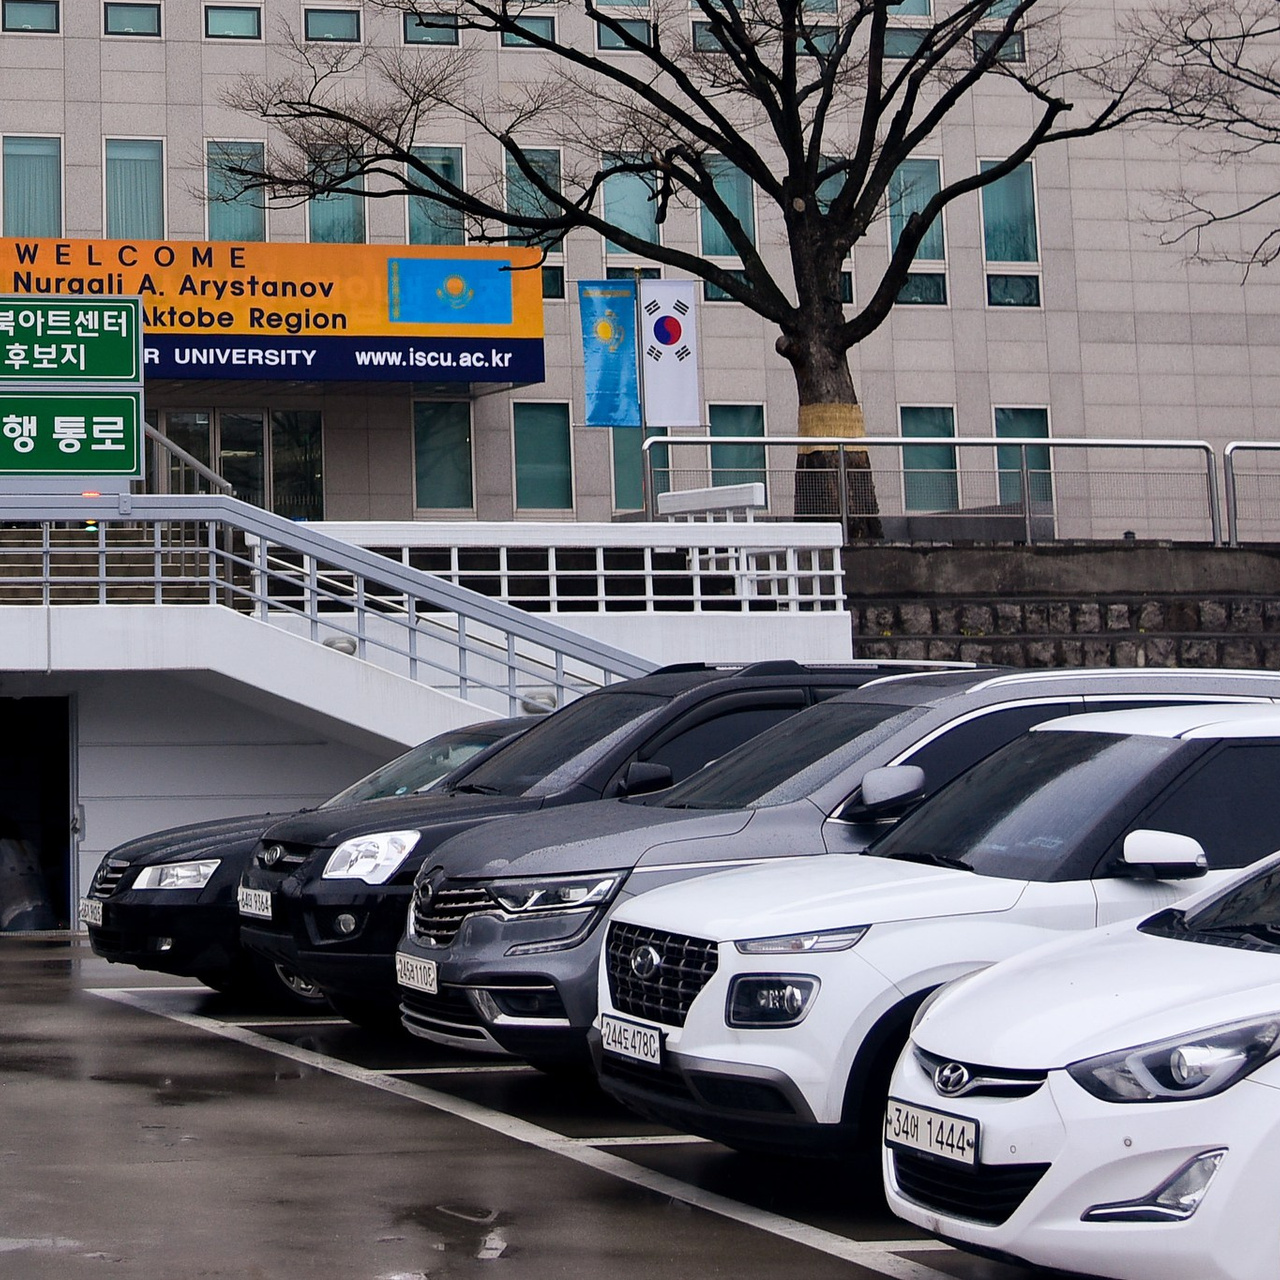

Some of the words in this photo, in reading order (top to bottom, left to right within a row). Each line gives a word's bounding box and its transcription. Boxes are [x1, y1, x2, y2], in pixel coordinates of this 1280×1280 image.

[15, 243, 246, 268] WELCOME
[137, 273, 165, 296] A.
[178, 273, 335, 301] Arystanov
[249, 307, 347, 334] Region
[4, 342, 86, 371] 후보지
[173, 347, 318, 366] UNIVERSITY
[354, 347, 513, 368] www.iscu.ac.kr
[52, 415, 127, 454] 통로
[926, 1116, 967, 1157] 1444
